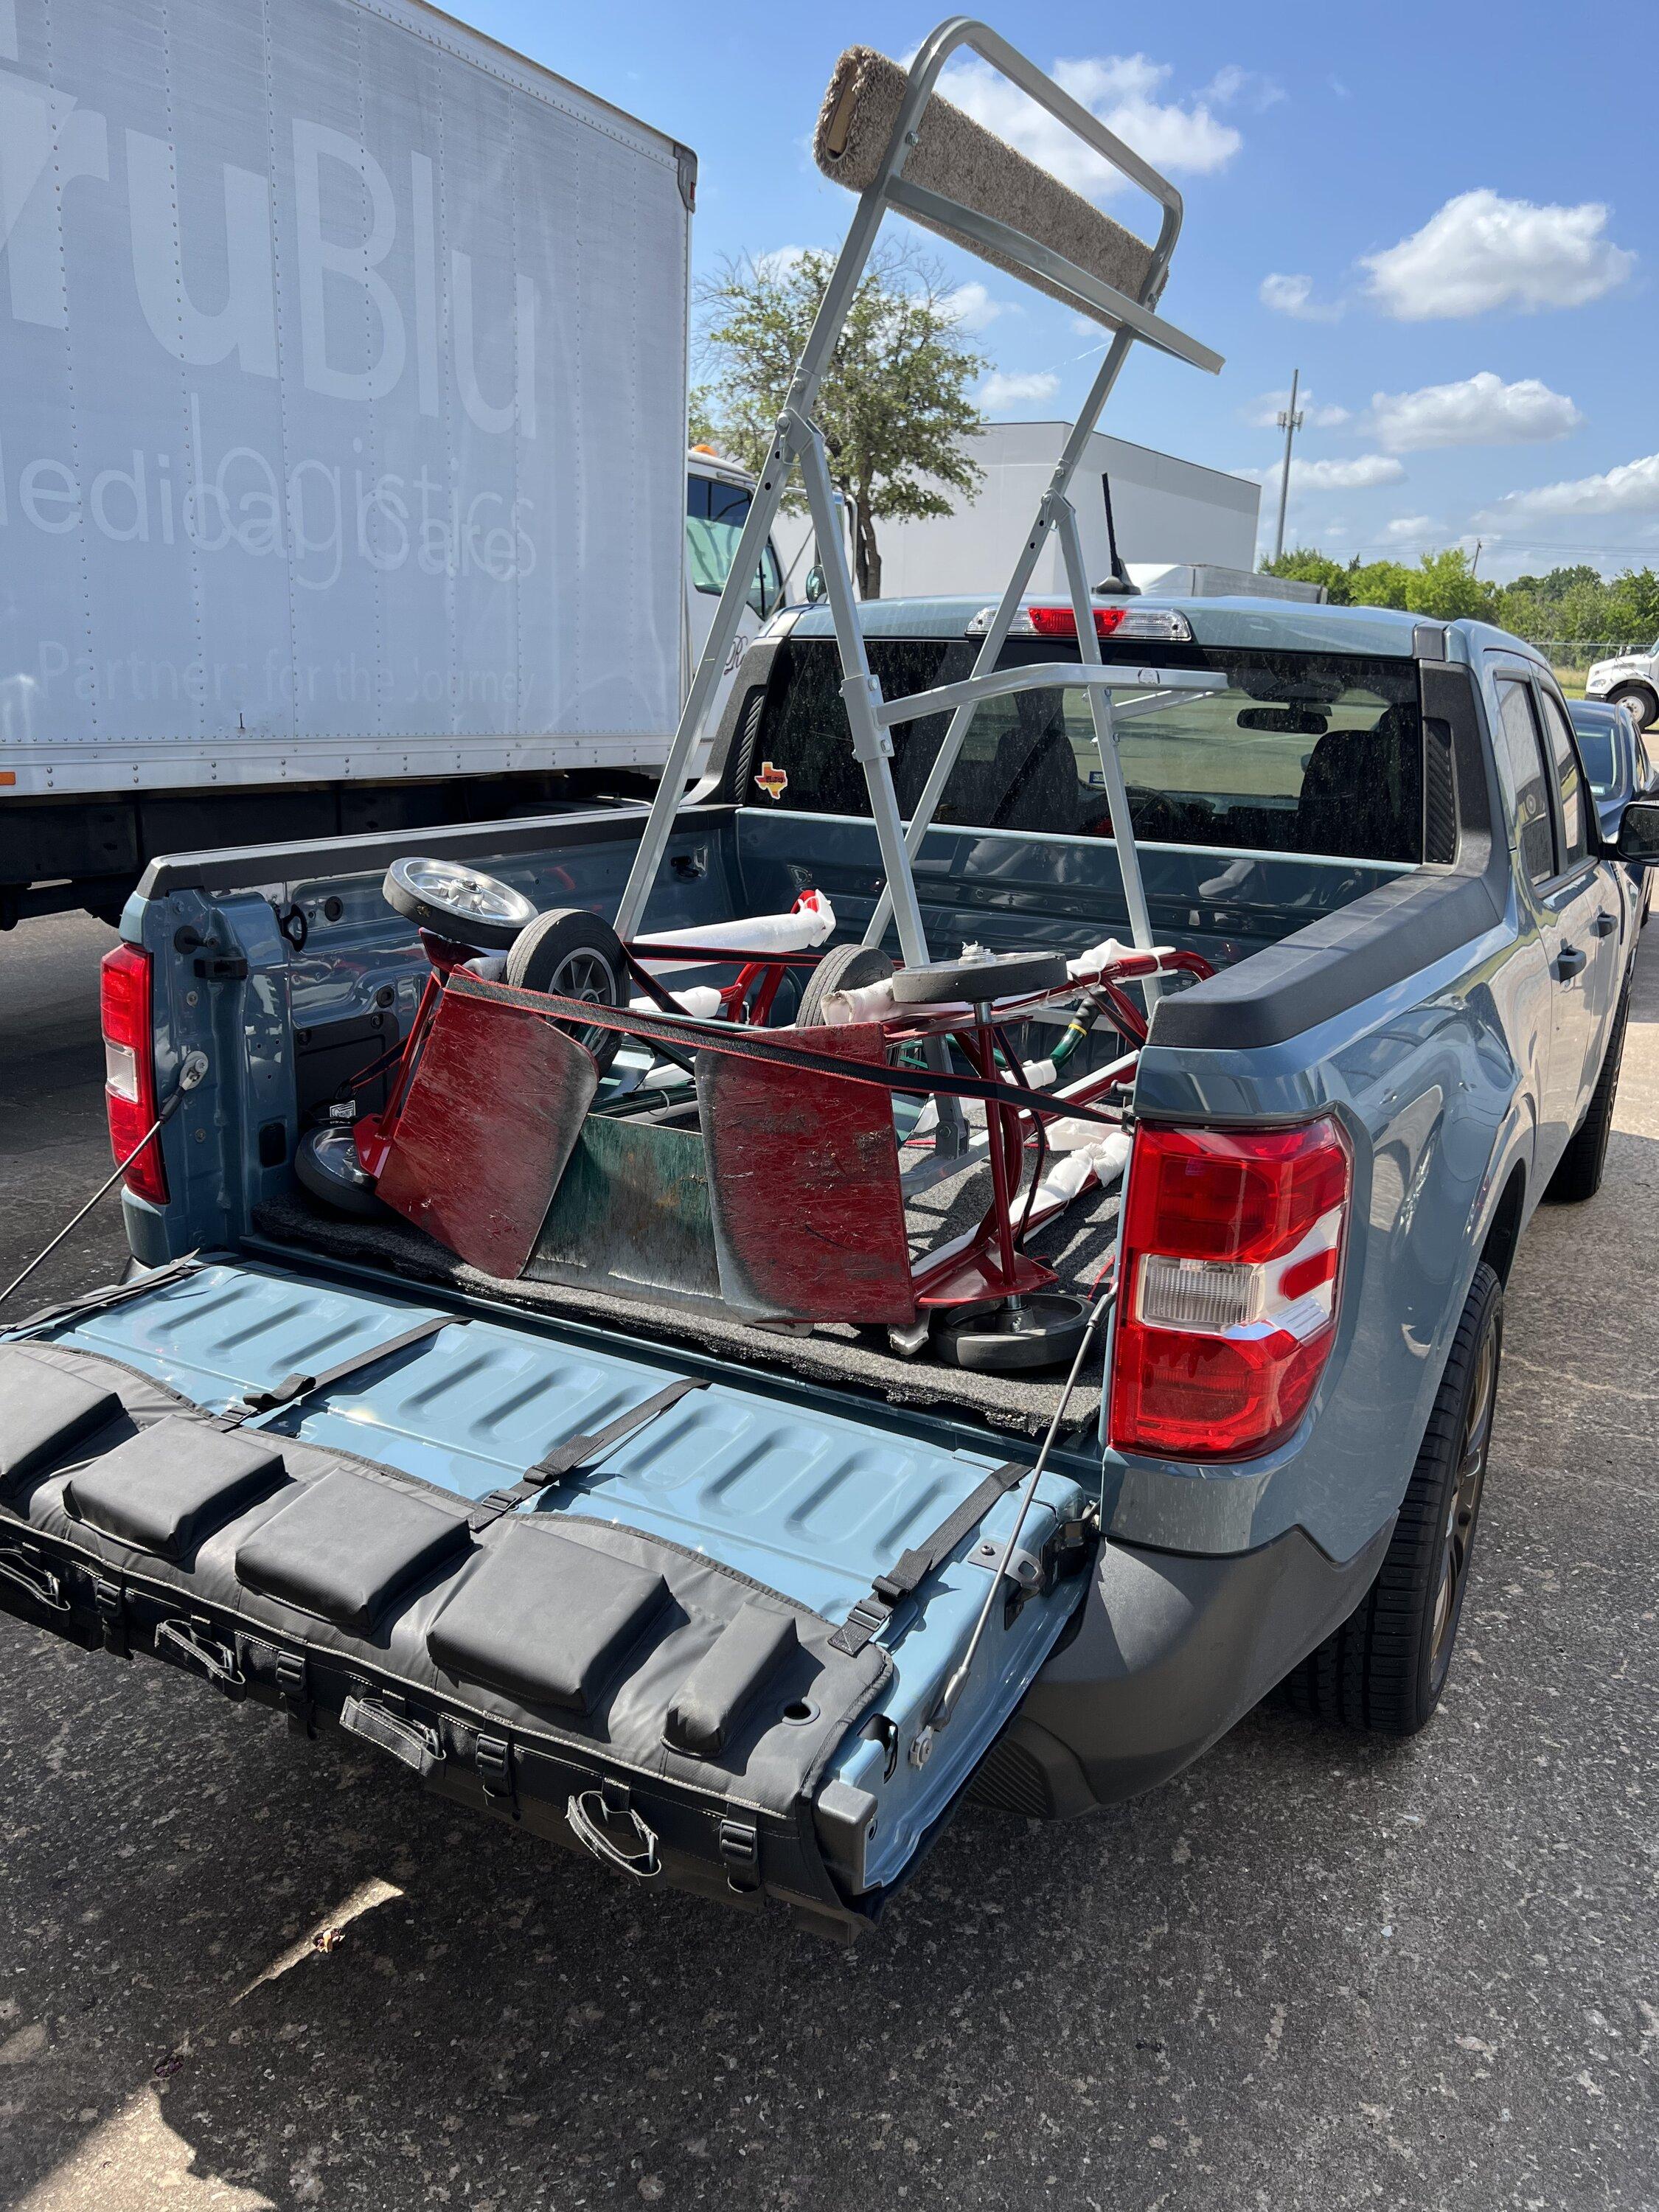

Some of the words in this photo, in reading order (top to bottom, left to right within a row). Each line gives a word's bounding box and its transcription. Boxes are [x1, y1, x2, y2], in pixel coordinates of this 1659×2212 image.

[0, 0, 537, 439] ruBlu
[0, 441, 305, 559] edical
[262, 648, 321, 702] for
[333, 652, 395, 703] the
[406, 655, 535, 711] Journey
